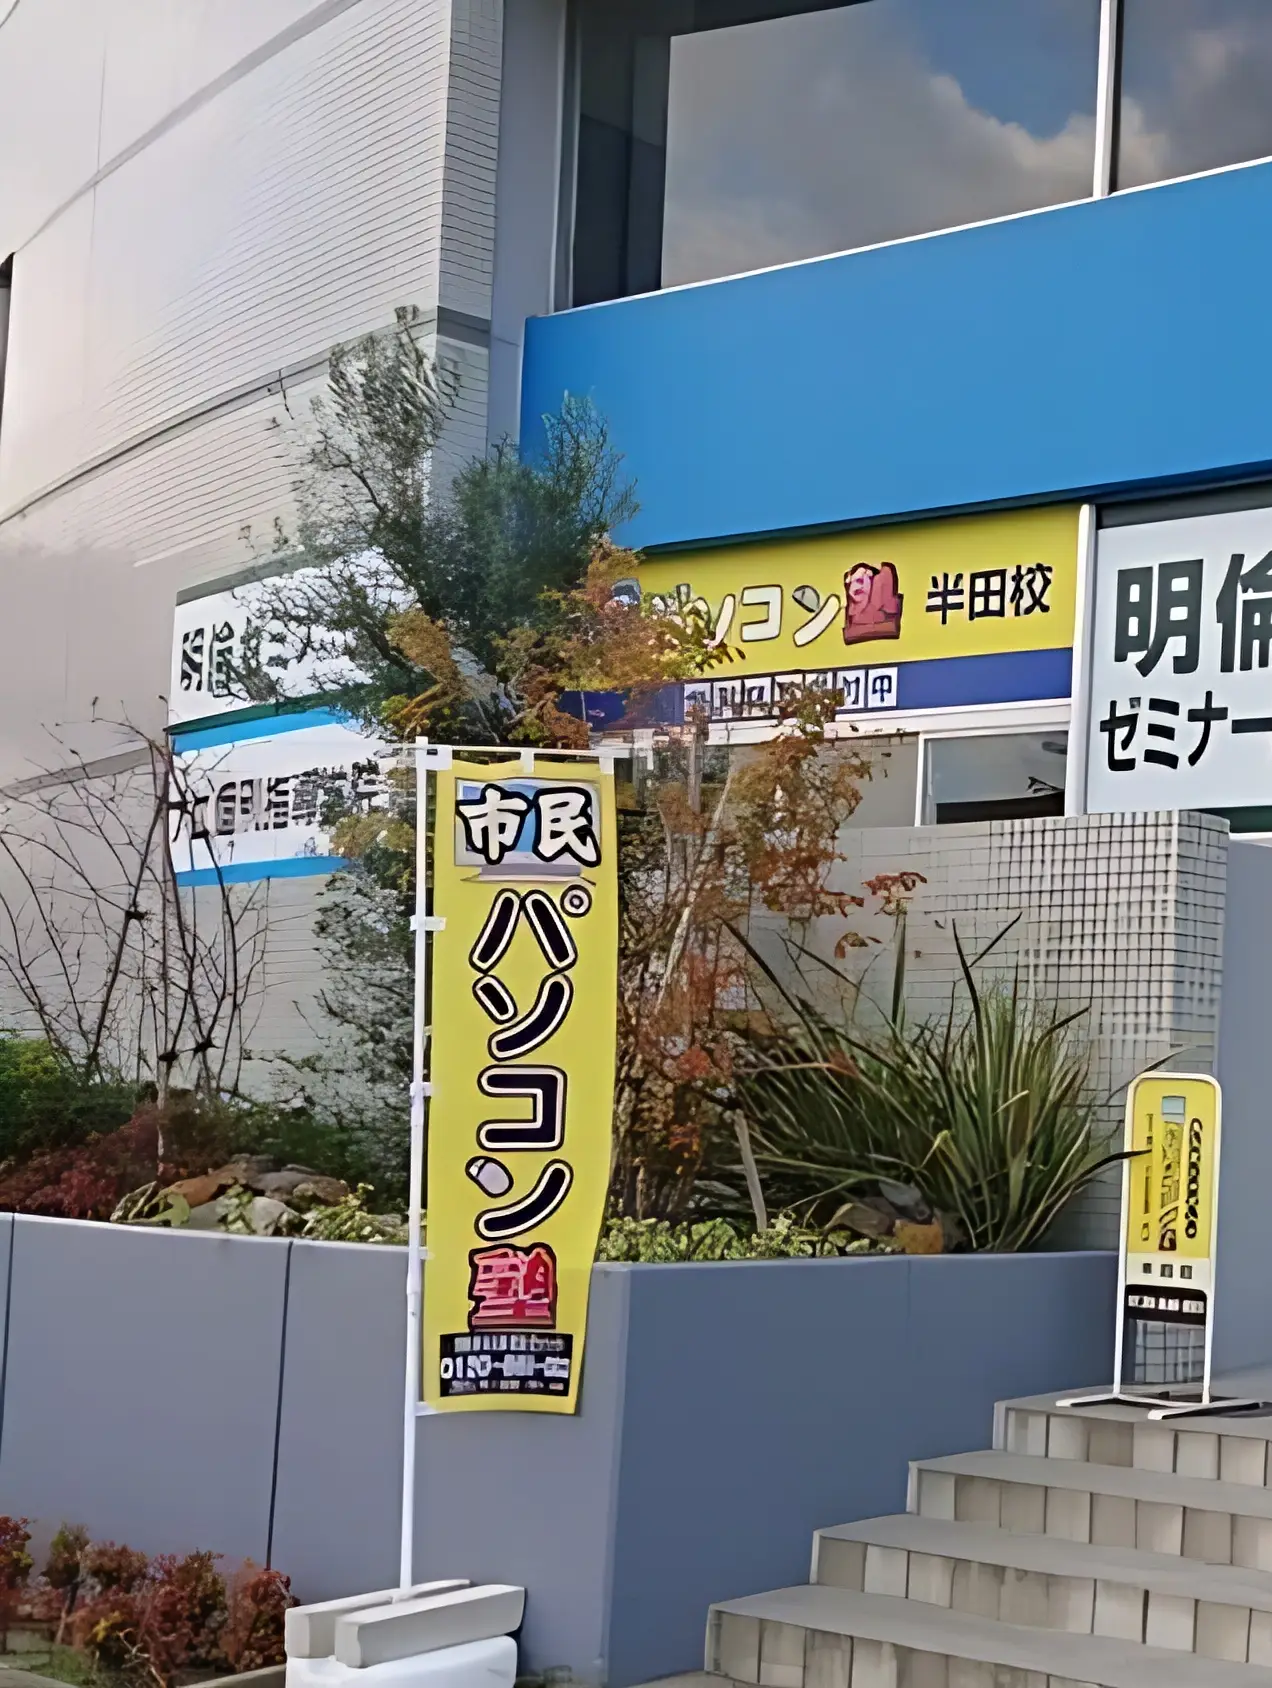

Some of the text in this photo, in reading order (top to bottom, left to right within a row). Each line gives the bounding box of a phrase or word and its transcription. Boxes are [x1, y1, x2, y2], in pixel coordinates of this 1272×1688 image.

[925, 562, 1053, 625] 半田校
[456, 784, 602, 867] 市民
